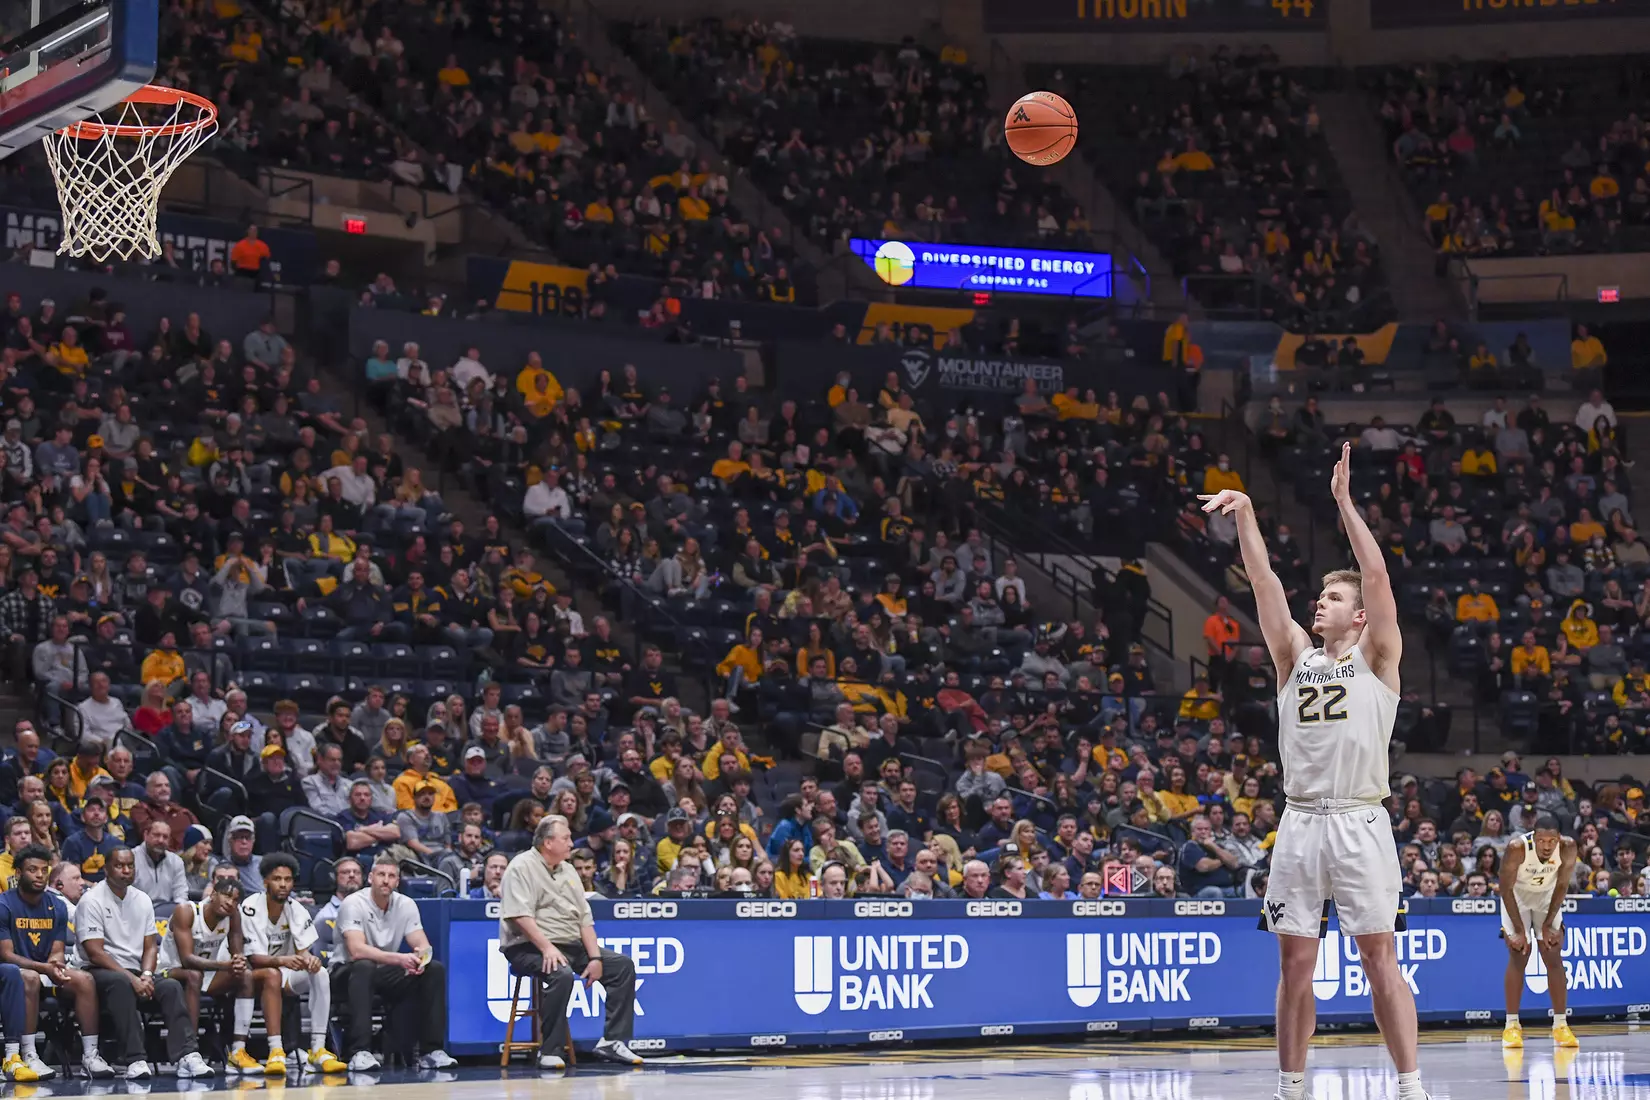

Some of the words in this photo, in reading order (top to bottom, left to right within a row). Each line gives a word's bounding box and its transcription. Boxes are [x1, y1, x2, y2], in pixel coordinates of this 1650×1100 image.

[922, 251, 1025, 271] DIVERSIFIED
[1031, 258, 1095, 275] ENERGY
[970, 274, 1023, 286] COMPANY
[1027, 277, 1049, 288] PLC
[938, 357, 1063, 380] MOUNTAINEER
[1298, 684, 1348, 723] 22
[613, 902, 678, 919] GEICO
[736, 901, 797, 918] GEICO
[854, 901, 913, 917] GEICO
[966, 901, 1023, 917] GEICO
[1072, 901, 1126, 916] GEICO
[1174, 901, 1226, 916] GEICO
[1452, 899, 1496, 914] GEICO
[839, 934, 970, 971] UNITED
[1106, 931, 1222, 966] UNITED
[1344, 928, 1447, 962] UTED
[597, 936, 685, 974] TED
[1345, 963, 1420, 997] BK
[1565, 959, 1623, 990] BANK
[839, 973, 935, 1011] BANK
[1107, 968, 1192, 1004] BANK
[566, 978, 645, 1018] AN
[1465, 1010, 1491, 1020] GEICO
[1627, 1003, 1650, 1013] GEICO
[981, 1025, 1014, 1036] GEICO
[1086, 1021, 1118, 1031] GEICO
[1189, 1017, 1219, 1028] GEICO
[628, 1038, 666, 1050] GEICO
[750, 1034, 787, 1046] GEICO
[869, 1030, 904, 1042] GEICO
